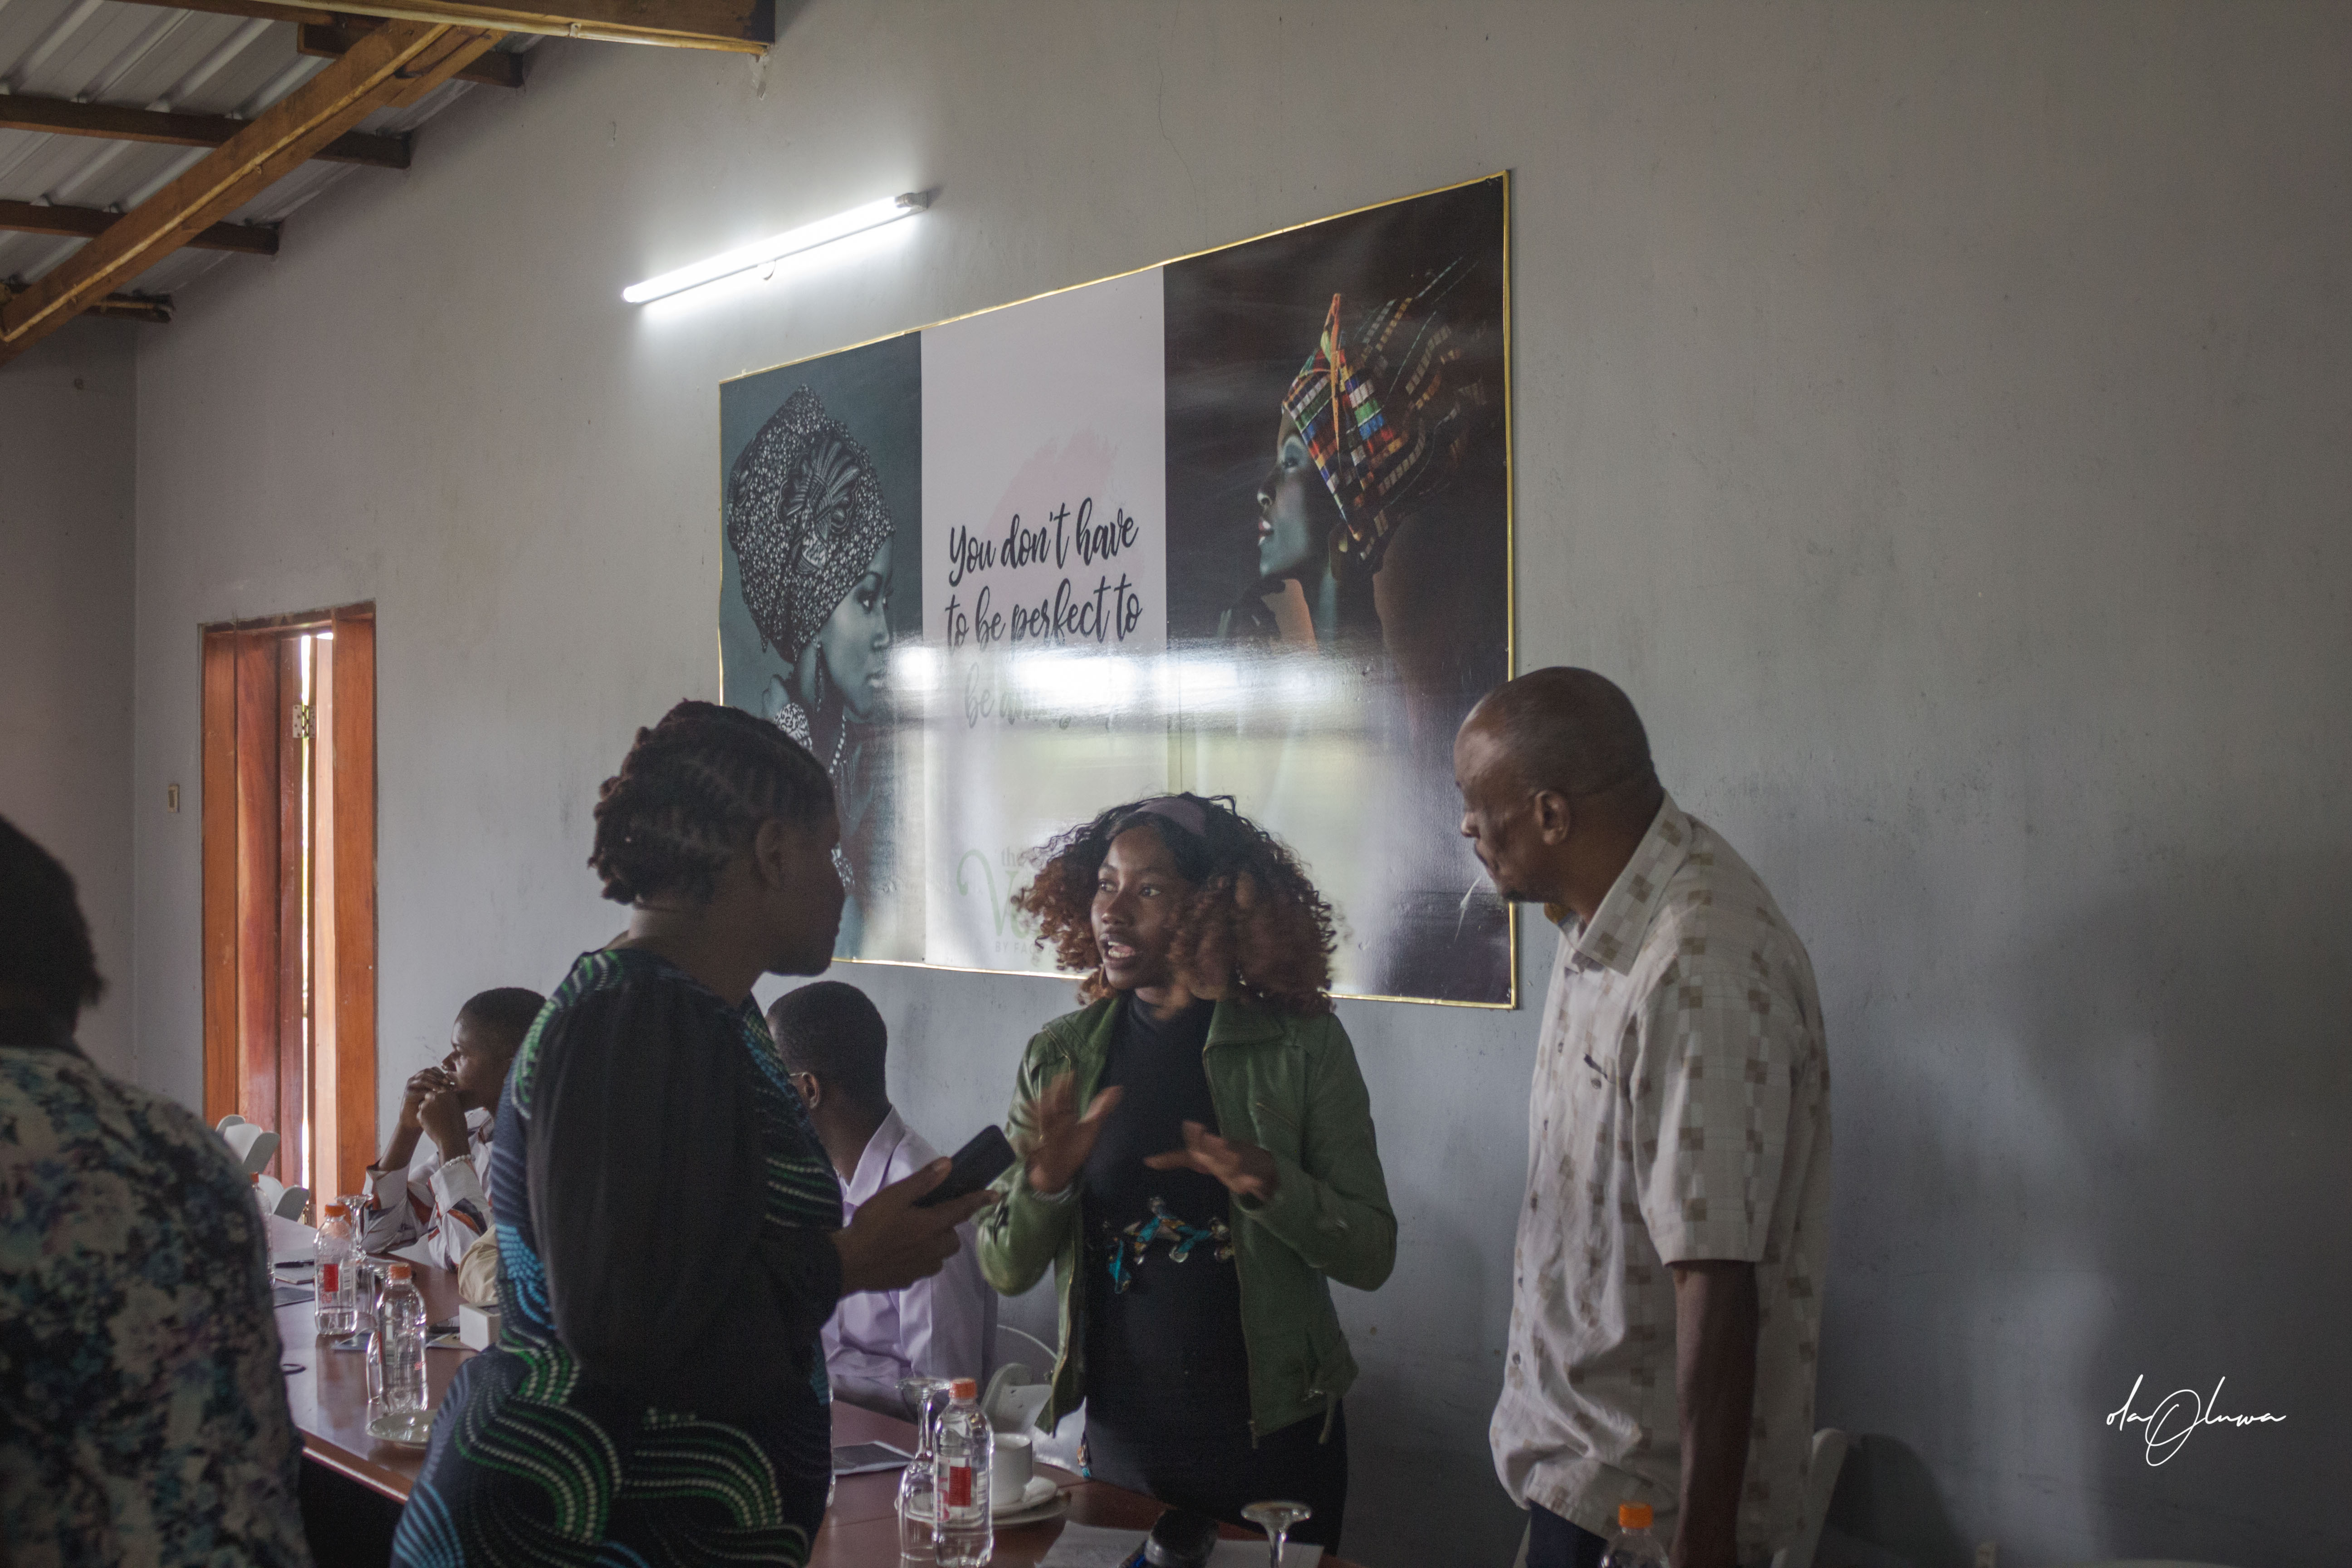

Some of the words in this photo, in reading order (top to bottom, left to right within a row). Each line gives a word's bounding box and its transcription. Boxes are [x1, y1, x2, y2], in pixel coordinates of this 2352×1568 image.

[1000, 502, 1071, 569] don't
[1076, 497, 1139, 566] have
[944, 594, 970, 656] to
[975, 585, 1006, 652] be
[1011, 575, 1112, 659] perfect
[1113, 573, 1143, 642] to
[964, 662, 995, 729] be
